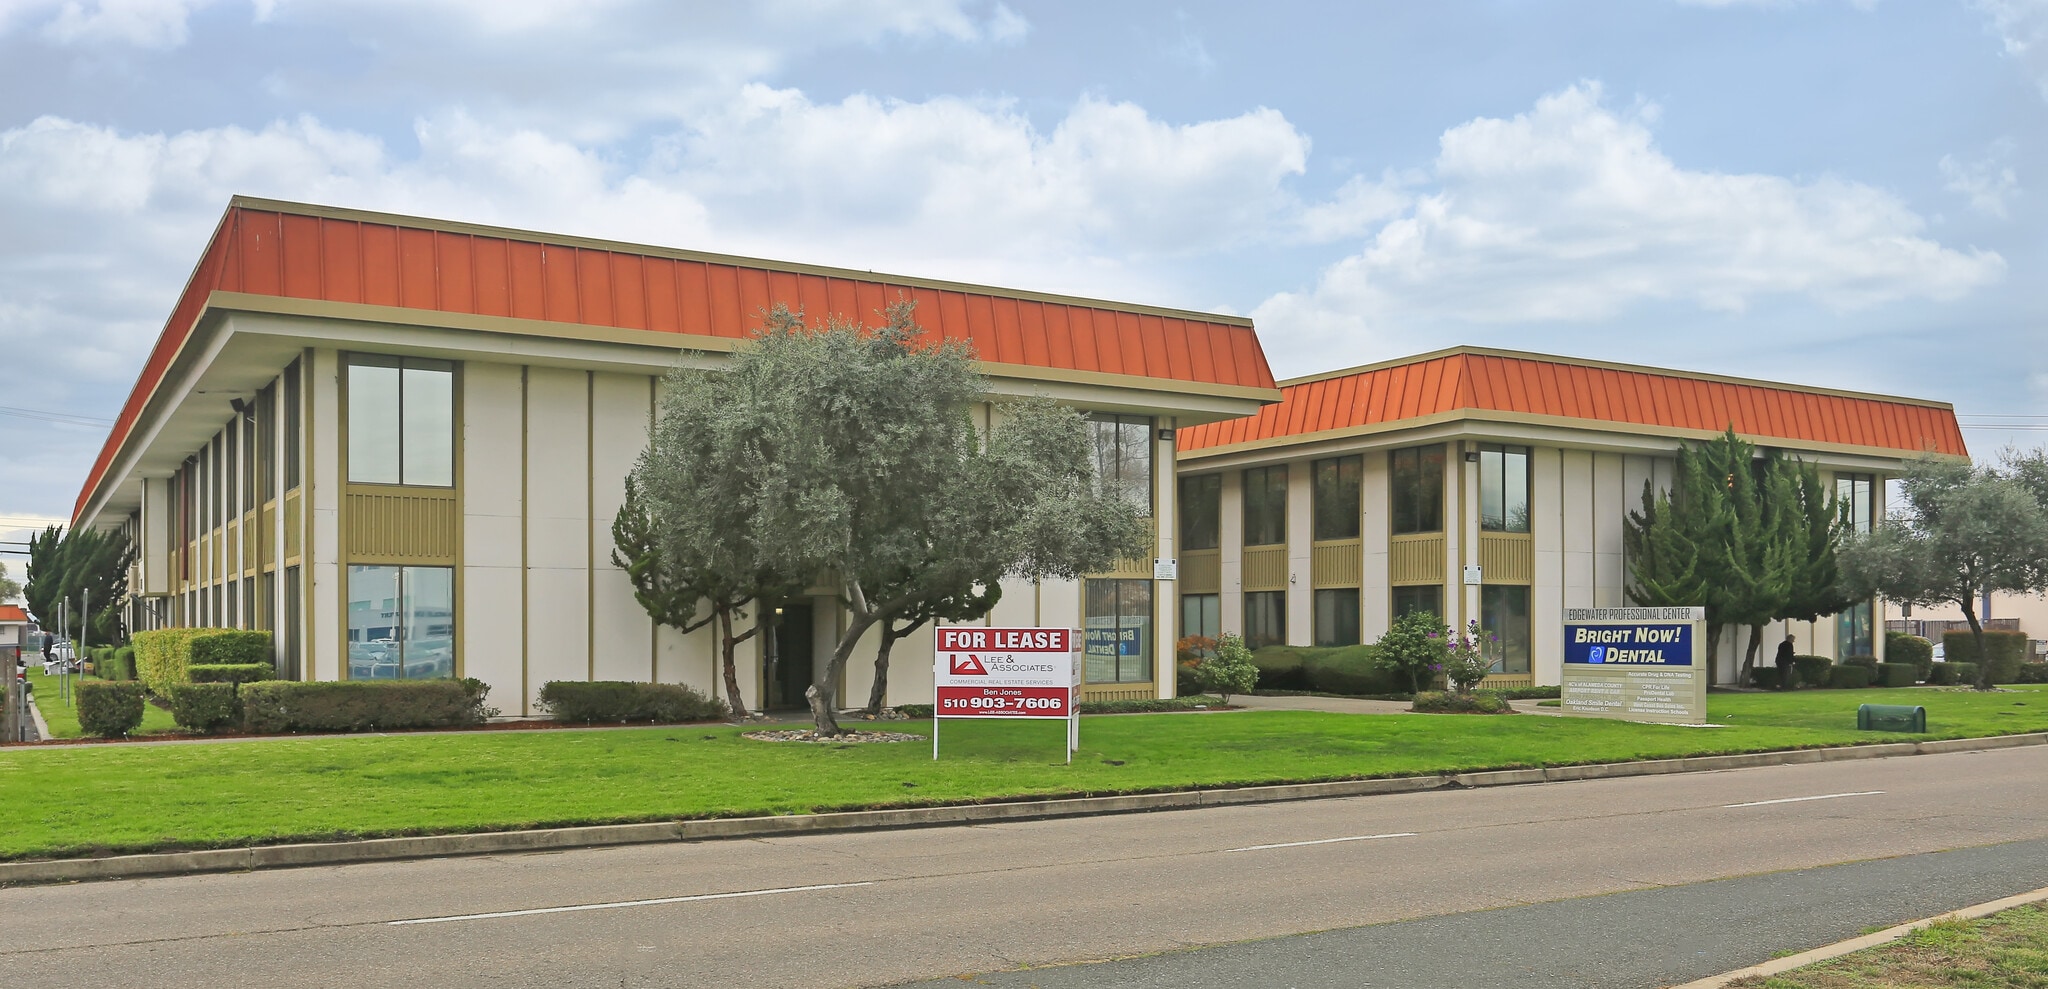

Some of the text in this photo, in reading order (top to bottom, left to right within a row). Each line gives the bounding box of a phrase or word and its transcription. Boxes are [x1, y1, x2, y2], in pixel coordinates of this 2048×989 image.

[1568, 607, 1691, 621] EDGEWATER PROFESSIONAL CENTER
[944, 631, 986, 649] FOR
[994, 631, 1062, 649] LEASE
[1575, 626, 1682, 643] BRIGHT NOW!
[984, 654, 1015, 664] LEE &
[1605, 647, 1666, 663] DENTAL
[991, 663, 1054, 672] ASSOCIATES
[944, 698, 968, 709] 510
[970, 697, 1062, 709] 903-7606
